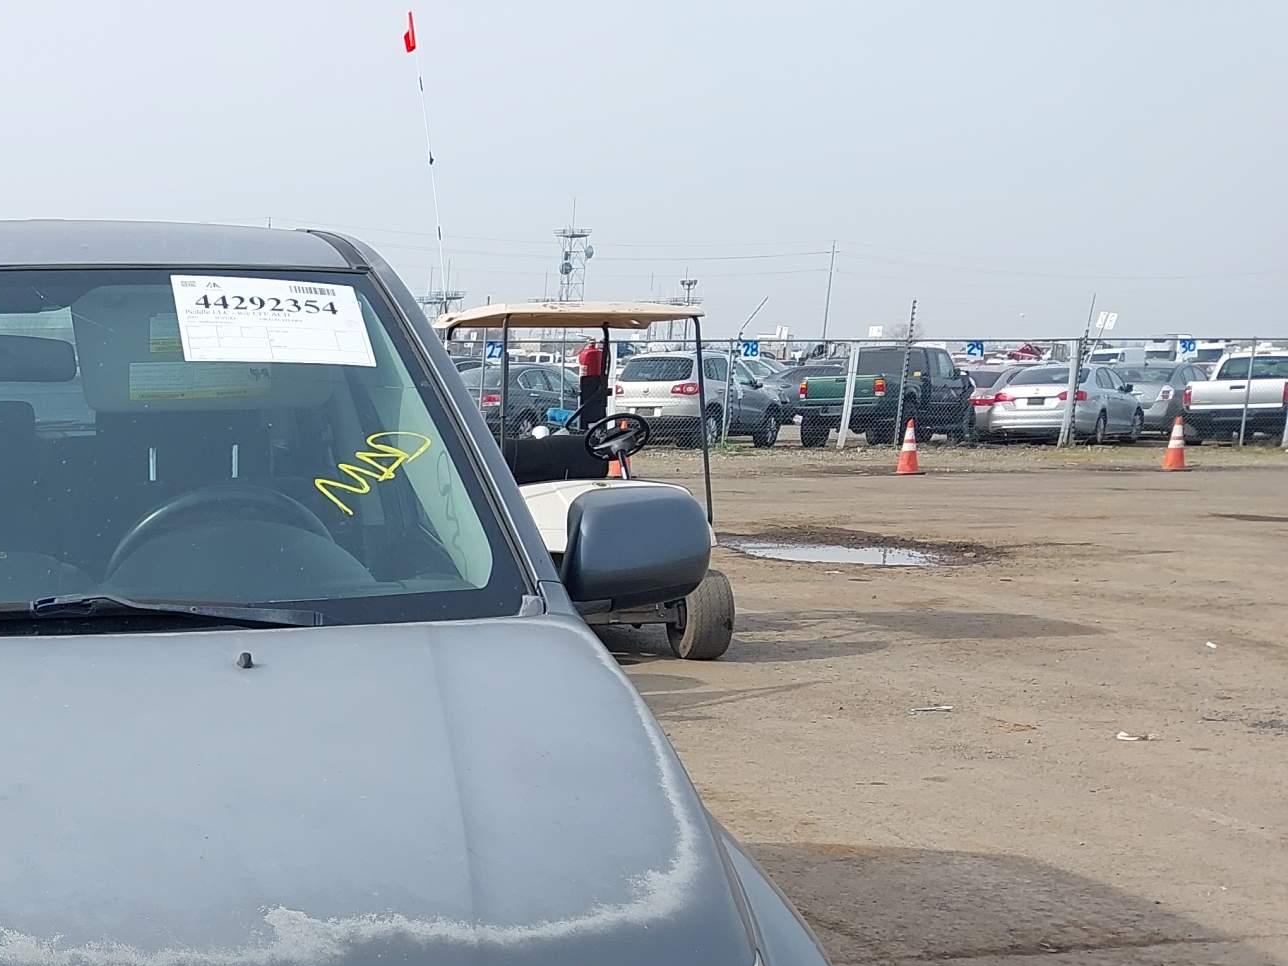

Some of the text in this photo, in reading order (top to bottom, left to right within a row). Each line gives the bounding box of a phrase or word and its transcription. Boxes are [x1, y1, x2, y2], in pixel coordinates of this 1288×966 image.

[195, 294, 339, 315] 44292354
[486, 341, 504, 359] 27
[742, 341, 759, 357] 28
[966, 341, 984, 357] 29
[1179, 338, 1197, 354] 30
